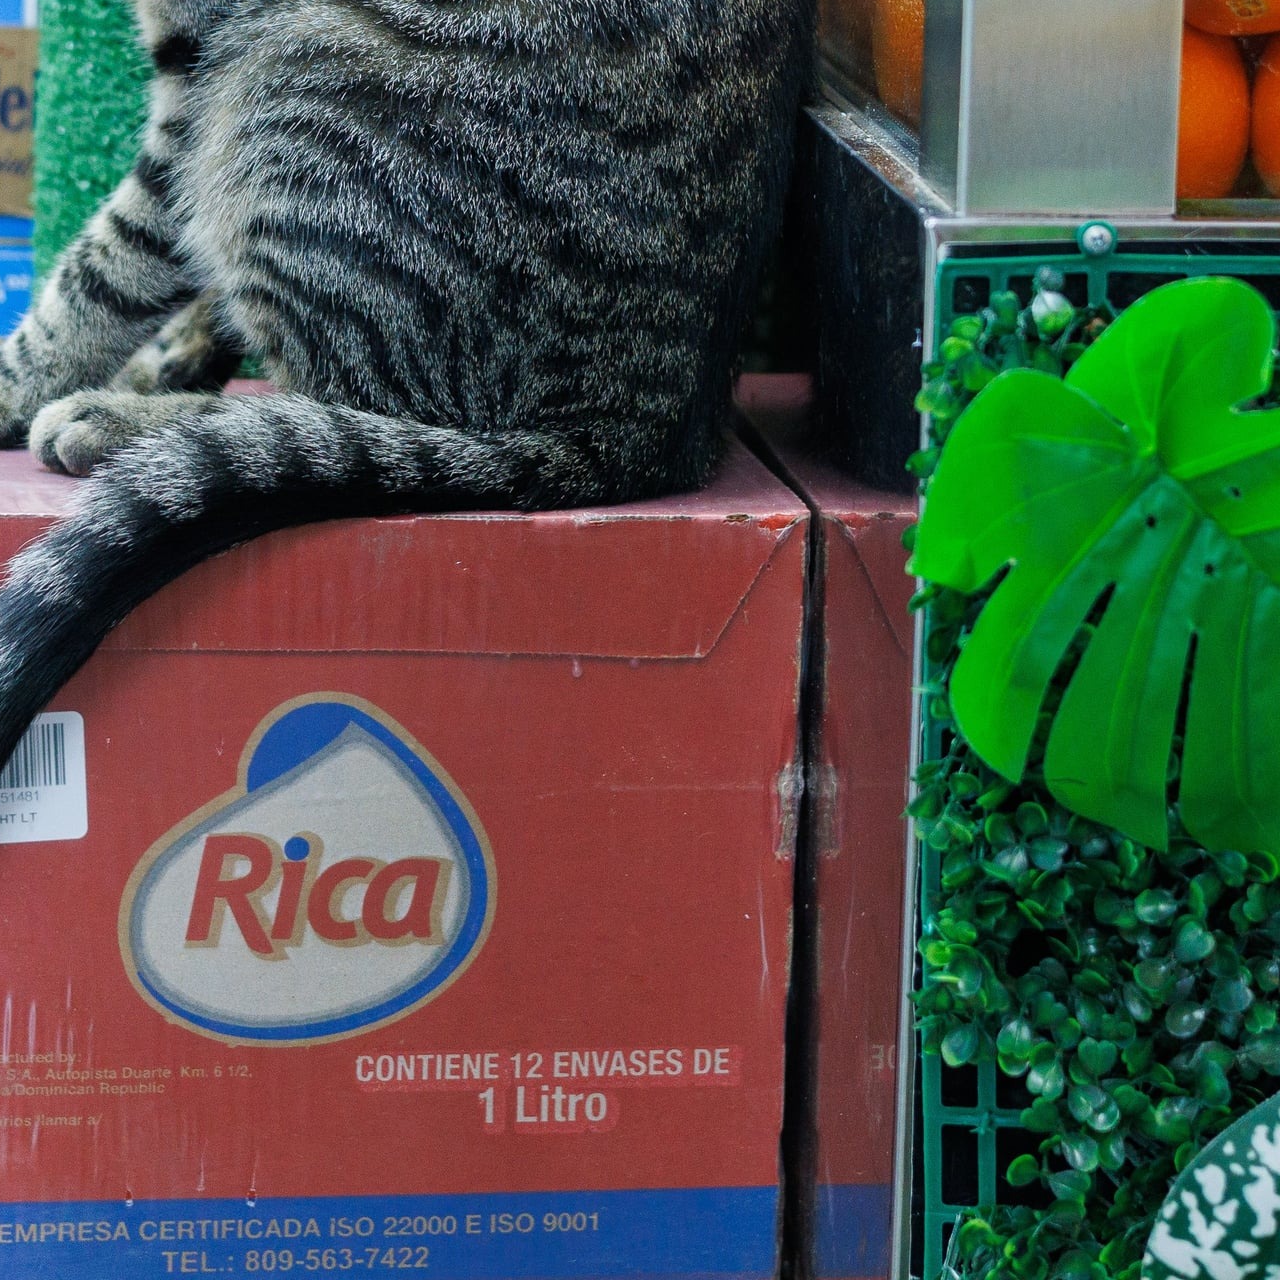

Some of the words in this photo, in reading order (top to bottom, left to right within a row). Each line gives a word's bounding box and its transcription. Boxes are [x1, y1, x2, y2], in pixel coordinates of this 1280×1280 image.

[185, 832, 453, 960] Rica
[45, 1067, 117, 1082] Autopista
[356, 1052, 499, 1083] CONTIENE
[510, 1051, 543, 1079] 12
[553, 1048, 684, 1078] ENVASES
[694, 1047, 730, 1075] DE
[100, 1082, 166, 1097] Republic
[478, 1086, 495, 1124] 1
[516, 1085, 608, 1123] Litro
[138, 1217, 321, 1241] CERTIFICADA
[330, 1216, 375, 1238] ISO
[383, 1214, 457, 1237] 22000
[465, 1214, 482, 1235] E
[490, 1212, 535, 1234] ISO
[542, 1211, 600, 1233] 9001
[161, 1251, 234, 1273] TEL.:
[245, 1246, 430, 1272] 809-563-7422
